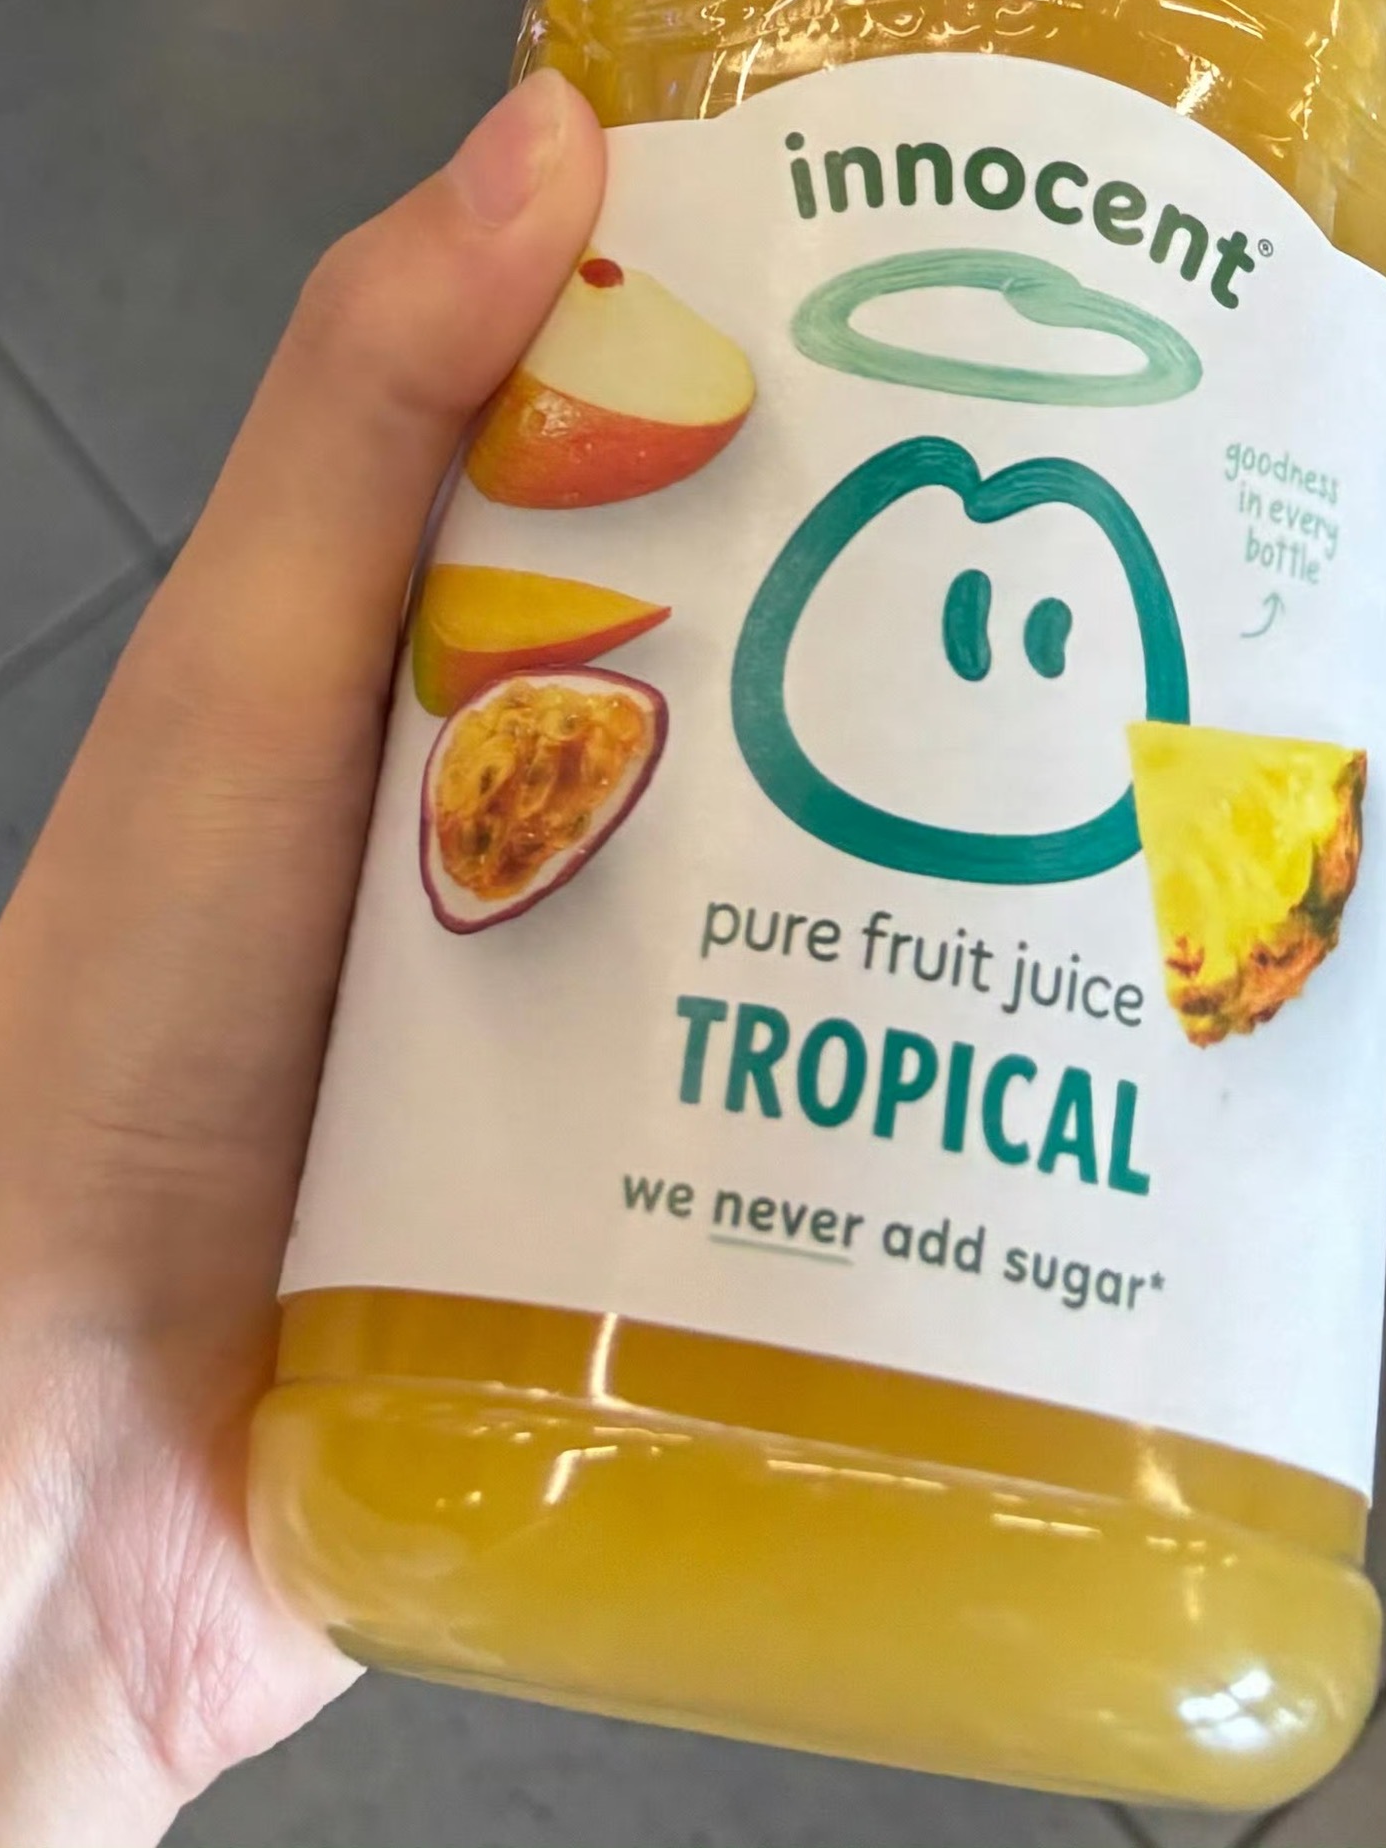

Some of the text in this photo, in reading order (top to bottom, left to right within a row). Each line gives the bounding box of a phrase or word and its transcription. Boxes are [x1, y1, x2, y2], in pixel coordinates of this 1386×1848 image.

[1225, 443, 1338, 505] goodness
[1238, 480, 1339, 562] in every
[1245, 524, 1321, 586] bottle
[700, 901, 1145, 1028] pure fruit juice
[675, 994, 1151, 1197] TROPICAL
[621, 1173, 694, 1218] we
[712, 1184, 865, 1250] never
[880, 1218, 985, 1275] add
